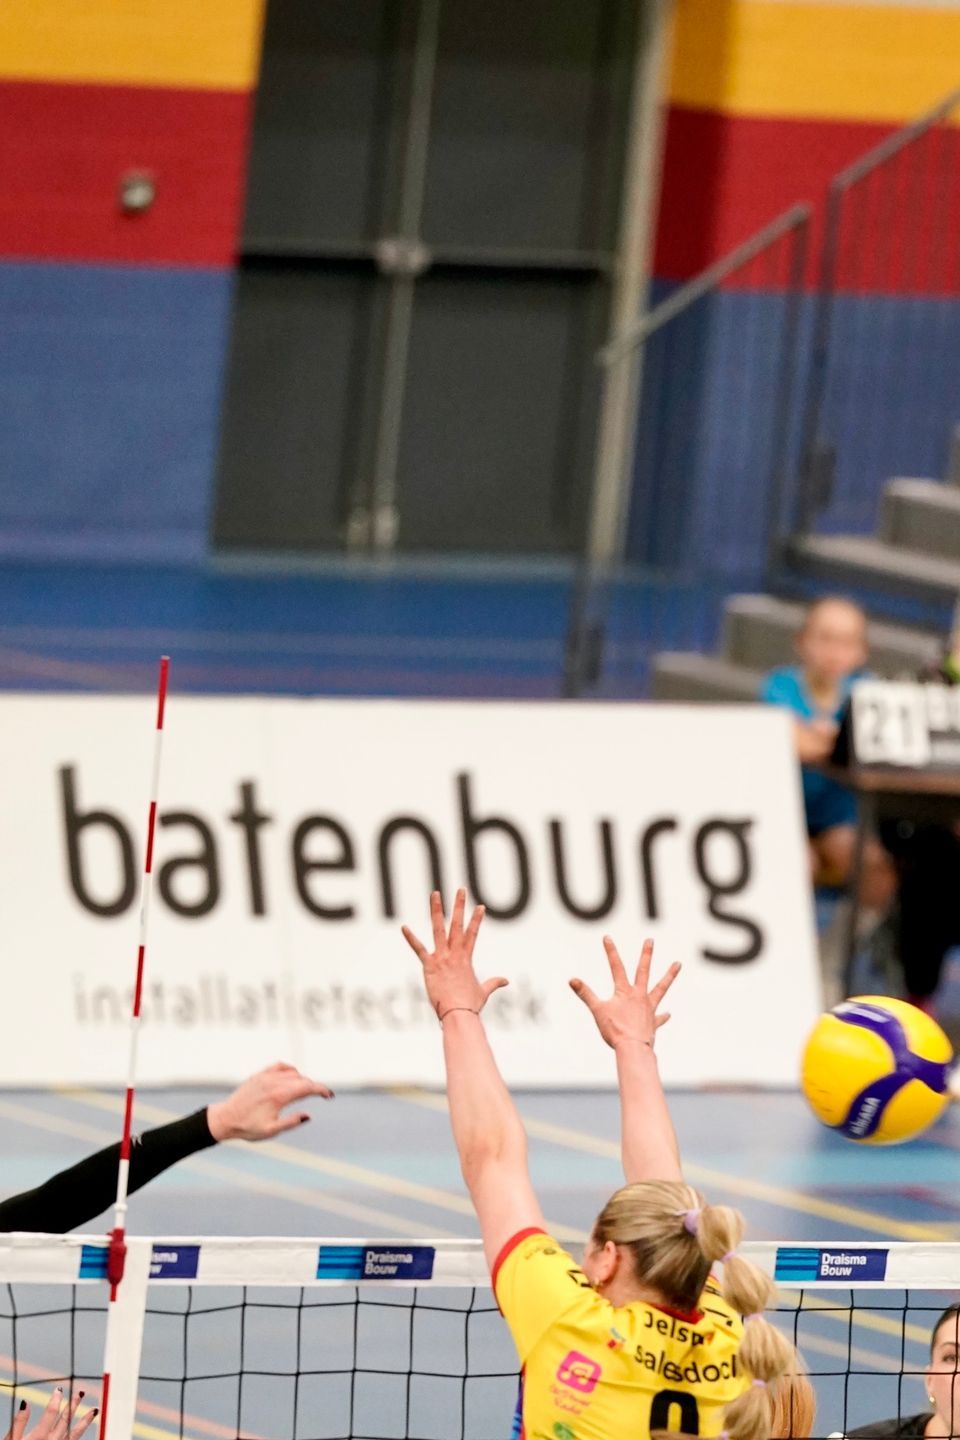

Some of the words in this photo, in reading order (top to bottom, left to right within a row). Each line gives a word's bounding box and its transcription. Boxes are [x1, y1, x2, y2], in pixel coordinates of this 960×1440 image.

[56, 761, 768, 966] batenburg
[365, 1251, 413, 1265] Draisma
[822, 1252, 867, 1266] Draisma
[364, 1262, 399, 1275] Bouw
[820, 1264, 852, 1277] Bouw
[634, 1344, 737, 1383] salesdoc
